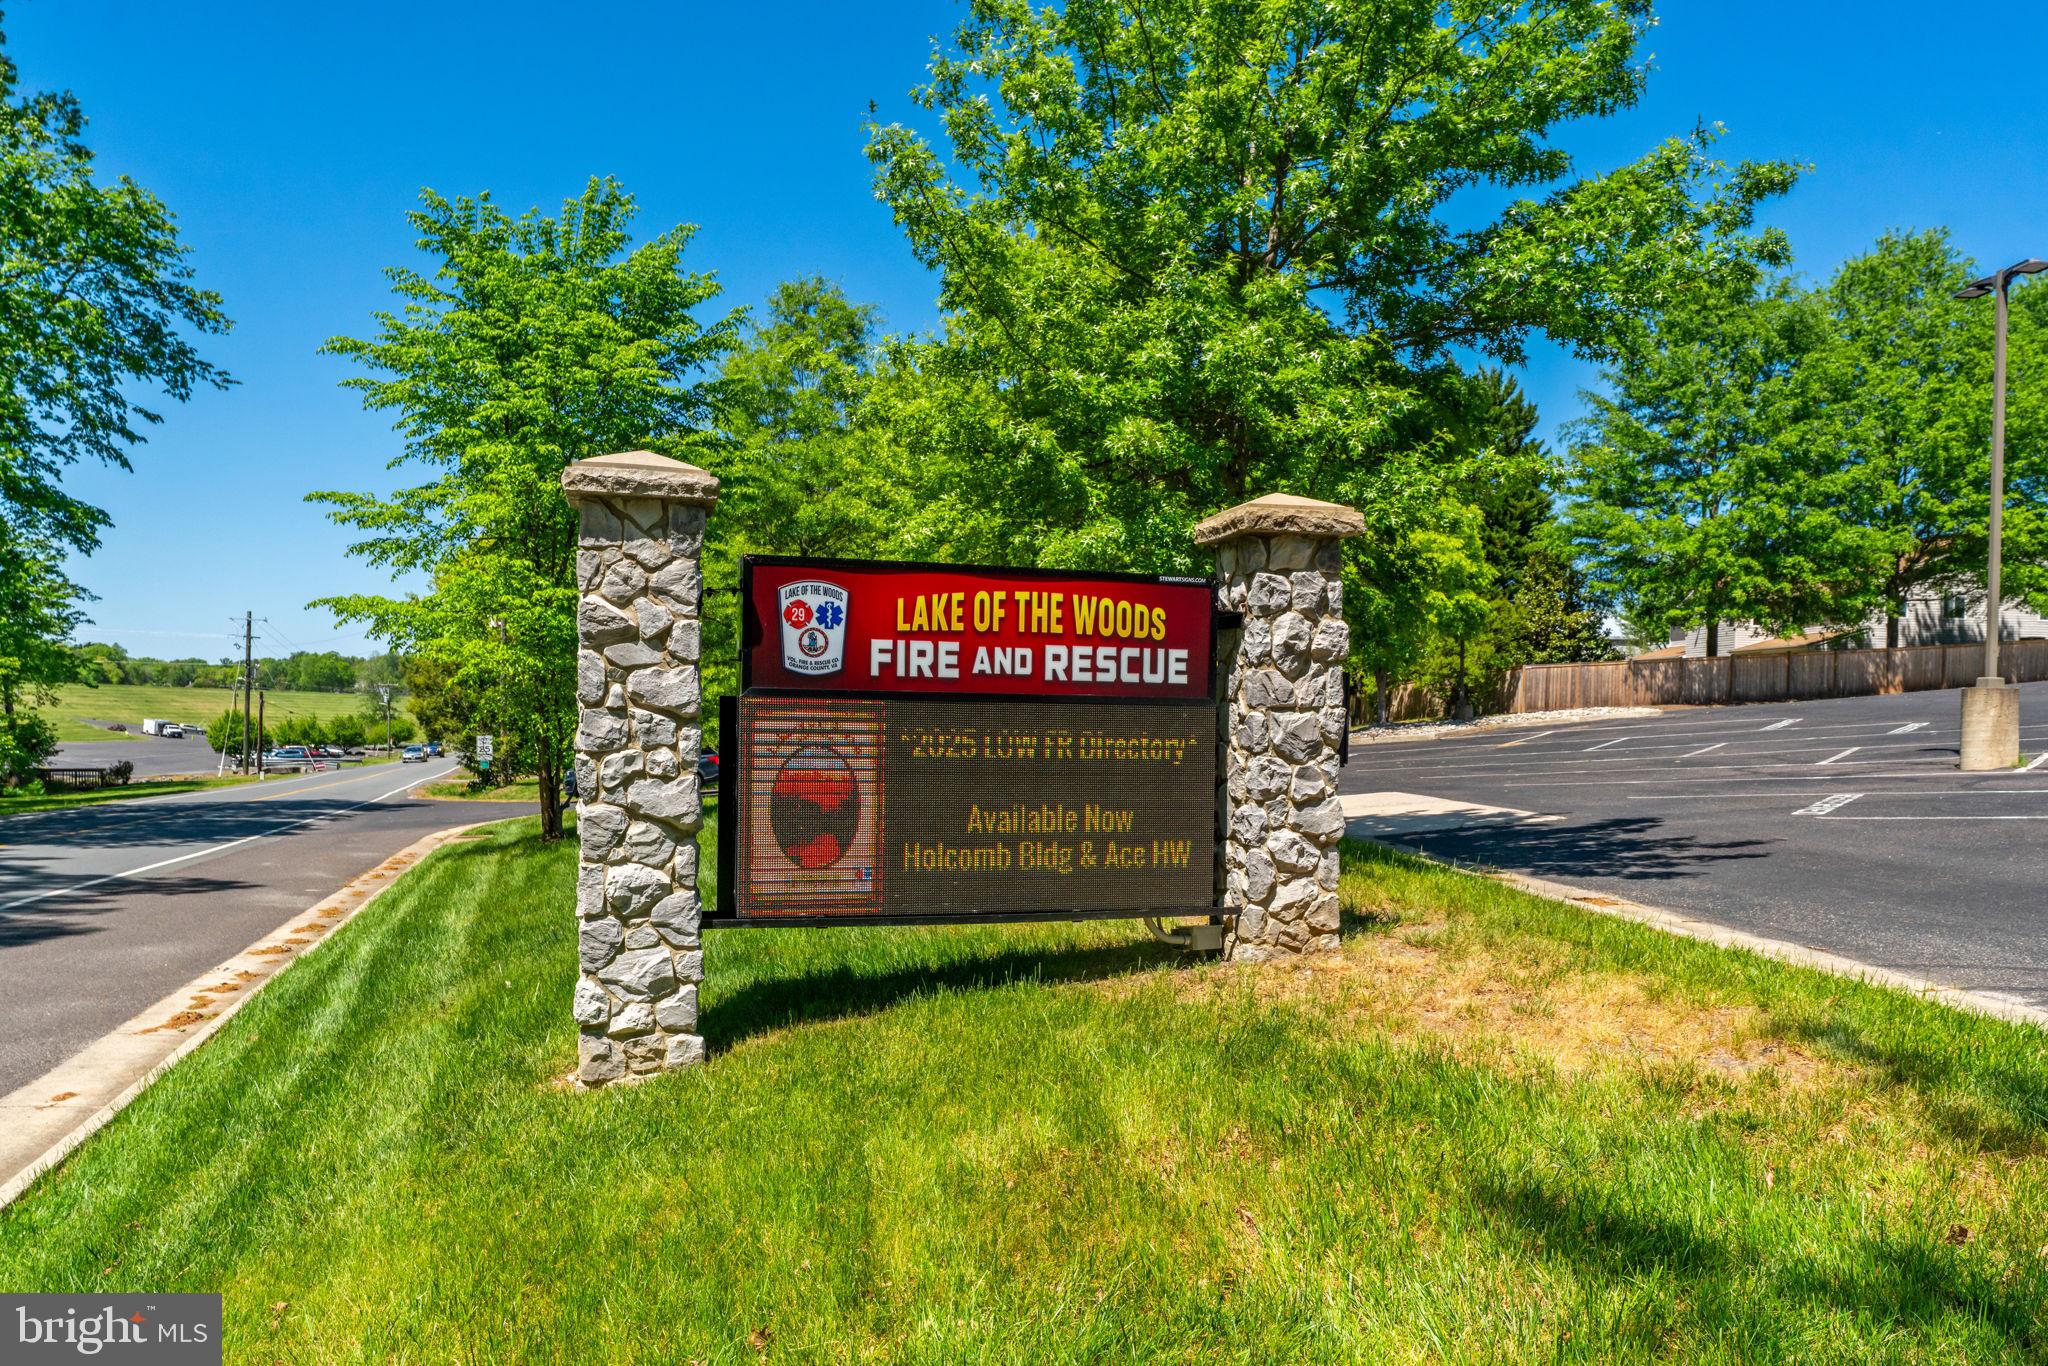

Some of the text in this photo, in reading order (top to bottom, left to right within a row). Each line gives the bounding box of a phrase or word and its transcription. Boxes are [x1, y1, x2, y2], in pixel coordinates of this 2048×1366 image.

[784, 584, 843, 601] LAKE OF THE WOODS
[791, 607, 805, 621] 29
[896, 590, 1167, 641] LAKE OF THE WOODS
[870, 638, 1189, 684] FIRE AND RESCUE
[966, 803, 1134, 833] Available Now
[903, 839, 1193, 874] Holcomb Bldg & Ace HW
